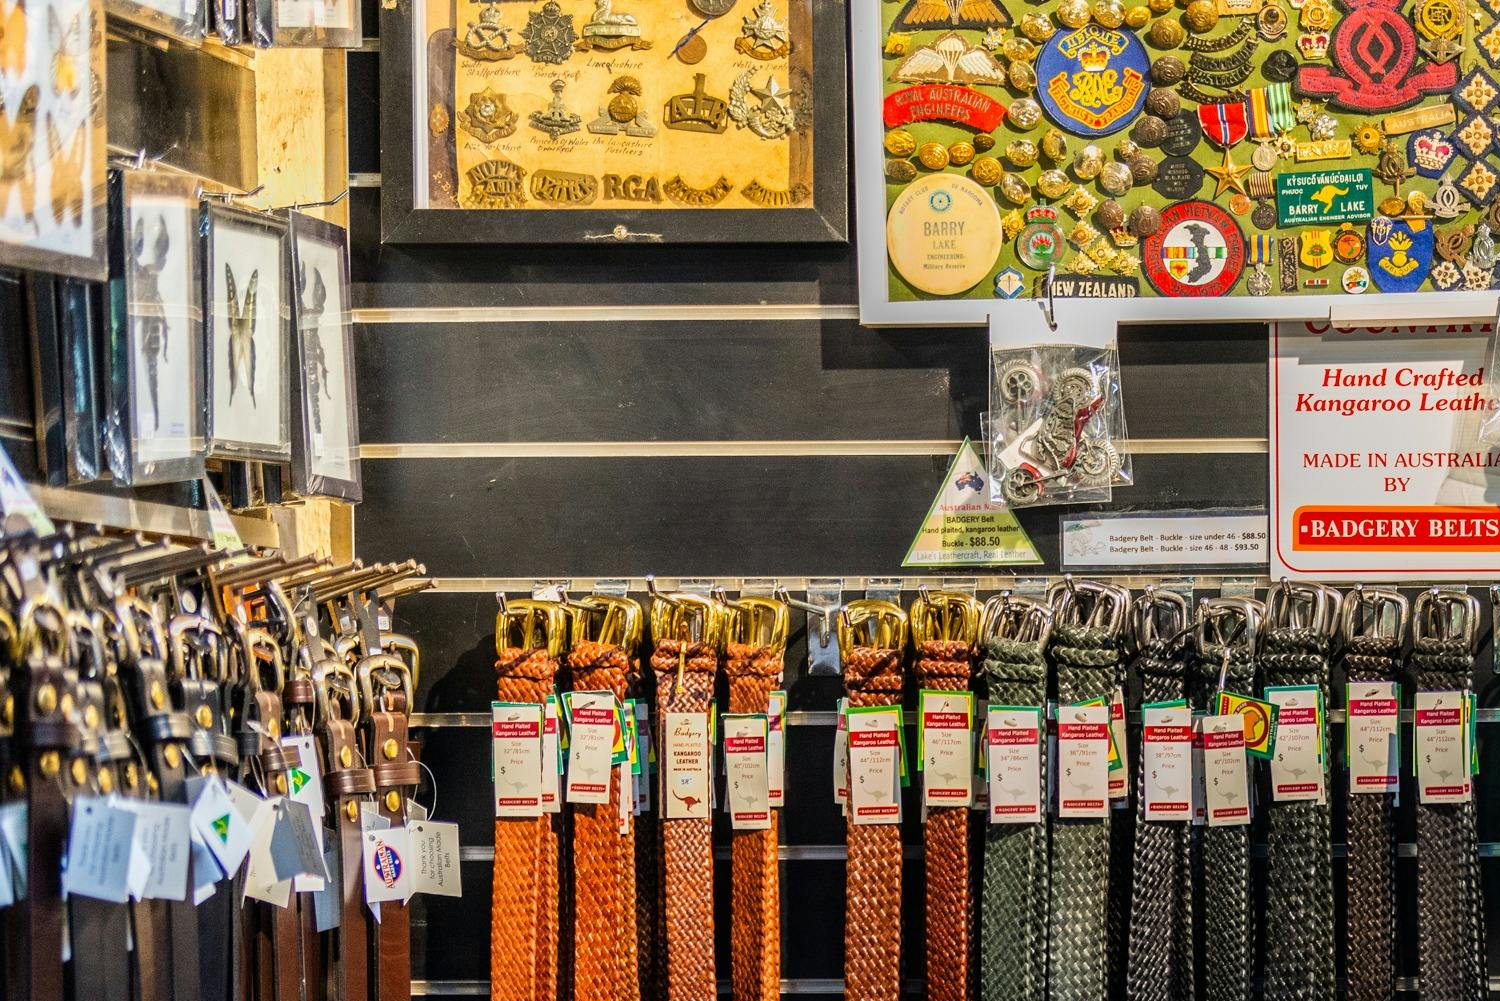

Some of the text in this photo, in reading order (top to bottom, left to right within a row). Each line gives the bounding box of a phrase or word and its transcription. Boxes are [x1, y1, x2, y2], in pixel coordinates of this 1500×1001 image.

[602, 173, 664, 202] RGA
[1289, 201, 1365, 215] BARRY LAKE
[923, 221, 965, 236] BARRY
[933, 240, 956, 249] LAKE
[1079, 281, 1136, 298] ZEALAND
[1321, 368, 1485, 388] Hand Crafted
[1295, 393, 1411, 416] Kangaroo
[1303, 452, 1361, 468] MADE
[1368, 452, 1388, 468] IN
[1384, 476, 1411, 492] BY
[1311, 519, 1500, 538] BADGERY BELTS
[942, 537, 1000, 548] Buckle $88.50
[1109, 535, 1138, 543] Badgery
[1139, 534, 1154, 542] Belt
[1204, 533, 1225, 541] under
[1242, 532, 1266, 540] $88.50
[1109, 546, 1138, 554] Badgery
[1234, 543, 1259, 551] $93.50
[674, 728, 701, 738] Badgery
